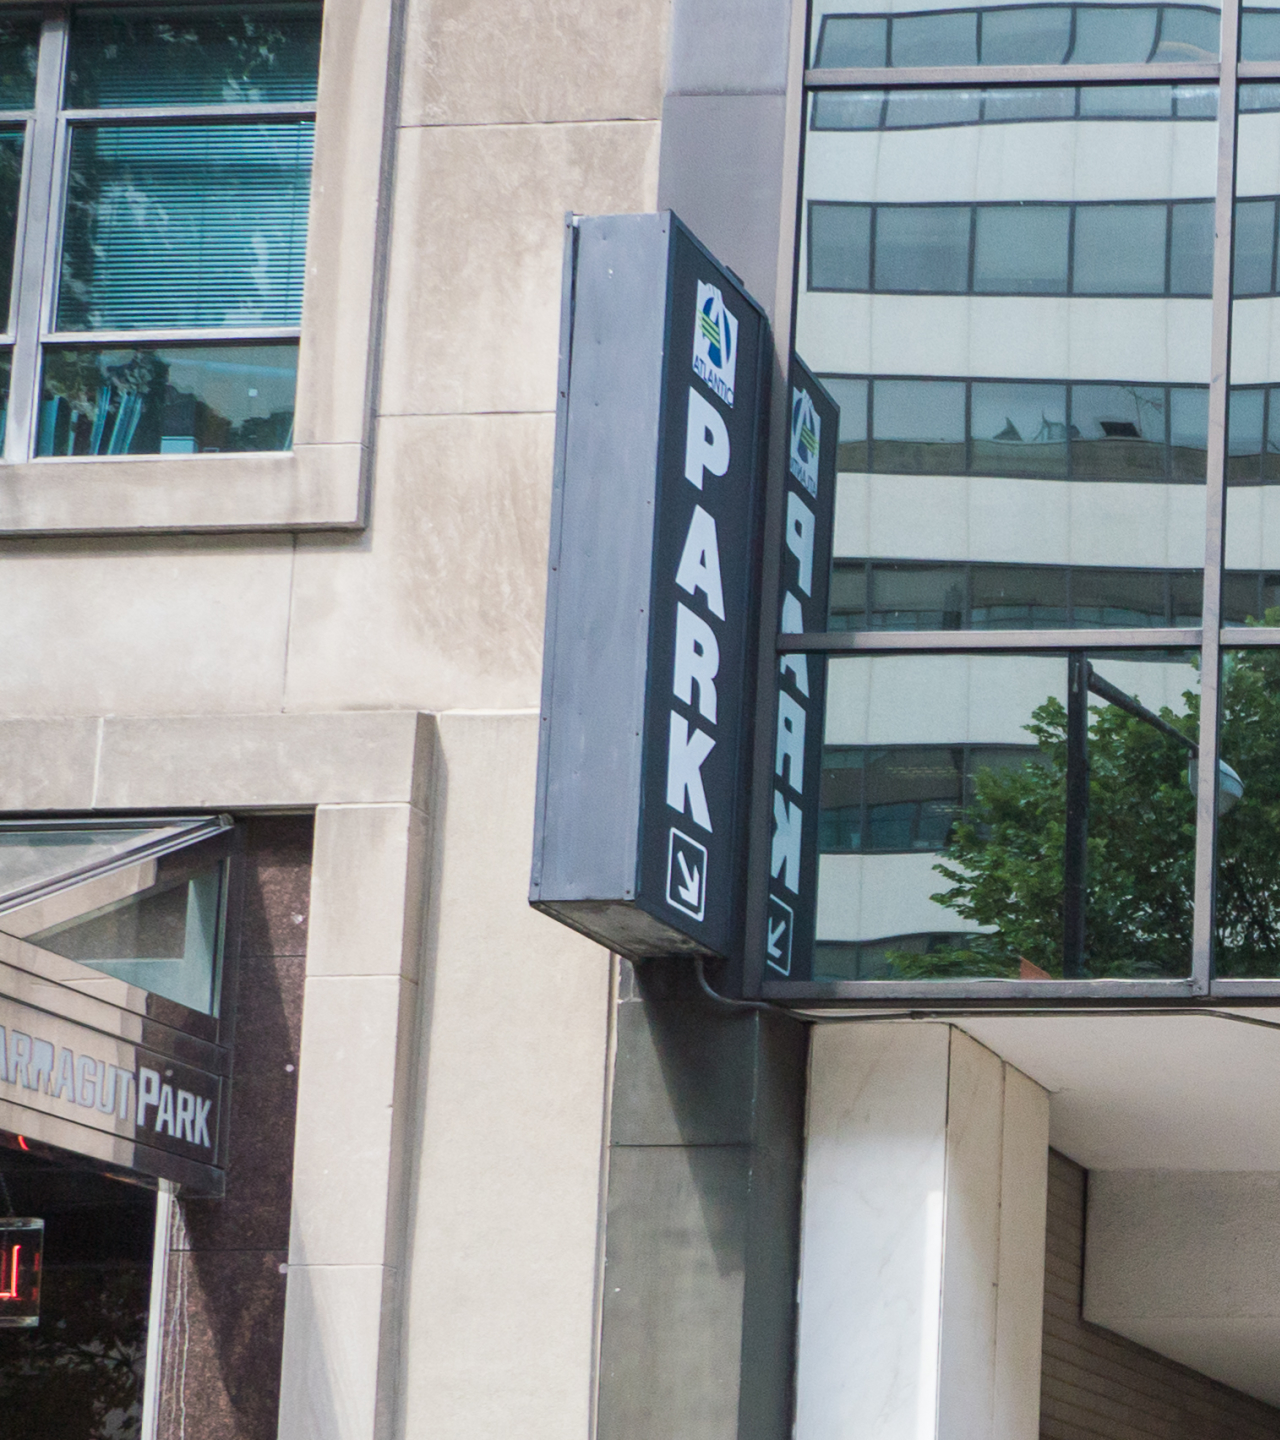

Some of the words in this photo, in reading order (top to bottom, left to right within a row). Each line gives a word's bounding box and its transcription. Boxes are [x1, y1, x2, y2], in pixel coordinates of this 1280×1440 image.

[693, 355, 734, 408] ATLANTIC
[666, 386, 731, 833] PARK
[137, 1066, 212, 1148] PARK
